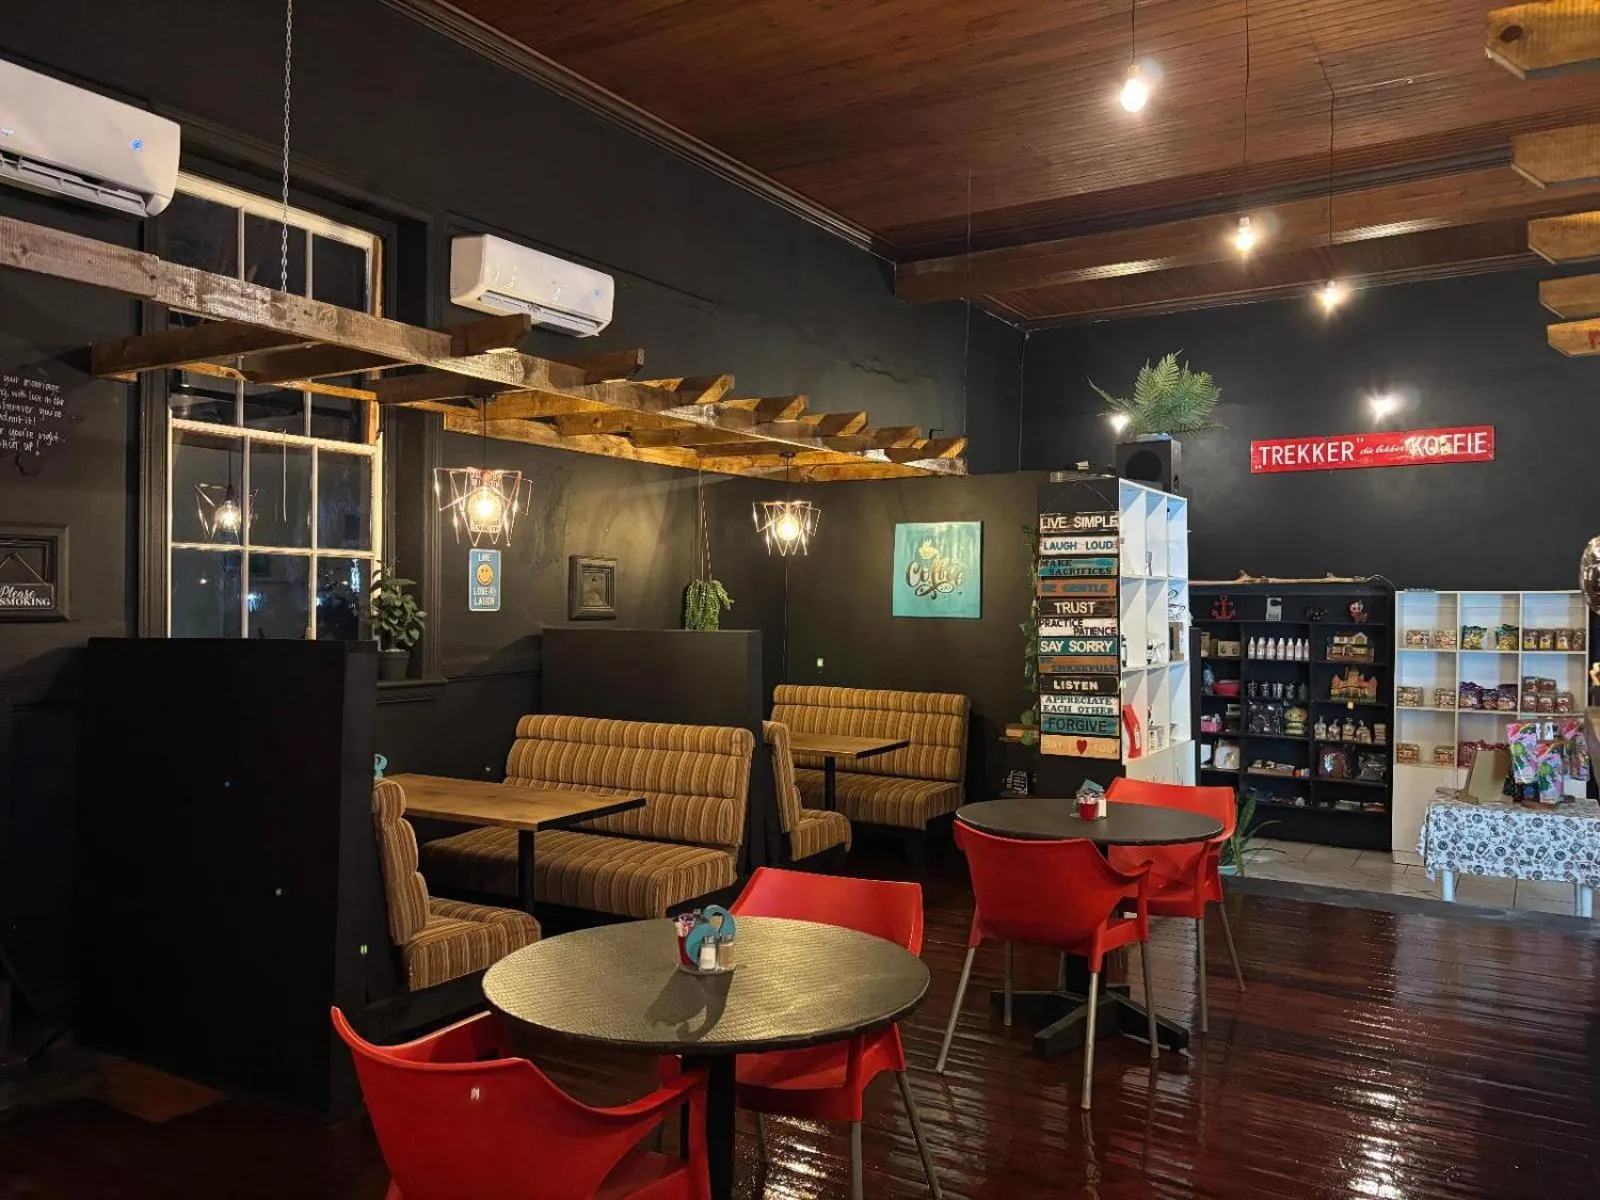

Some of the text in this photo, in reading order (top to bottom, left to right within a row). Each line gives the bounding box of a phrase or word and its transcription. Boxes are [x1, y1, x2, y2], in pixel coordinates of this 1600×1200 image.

[1041, 515, 1118, 529] LIVE SIMPLE
[1044, 540, 1113, 551] LAUGH LOUD
[1048, 566, 1112, 576] SACRIFICES
[1054, 601, 1096, 614] TRUST
[1039, 618, 1084, 628] PRACTICE
[1073, 626, 1117, 636] PATIENCE
[1040, 640, 1113, 653] SAY SORRY
[1053, 680, 1098, 691] LISTEN
[1045, 695, 1113, 705] APPRECIATE
[1043, 704, 1114, 714] EACH OTHER
[1048, 717, 1107, 732] FORGIVE
